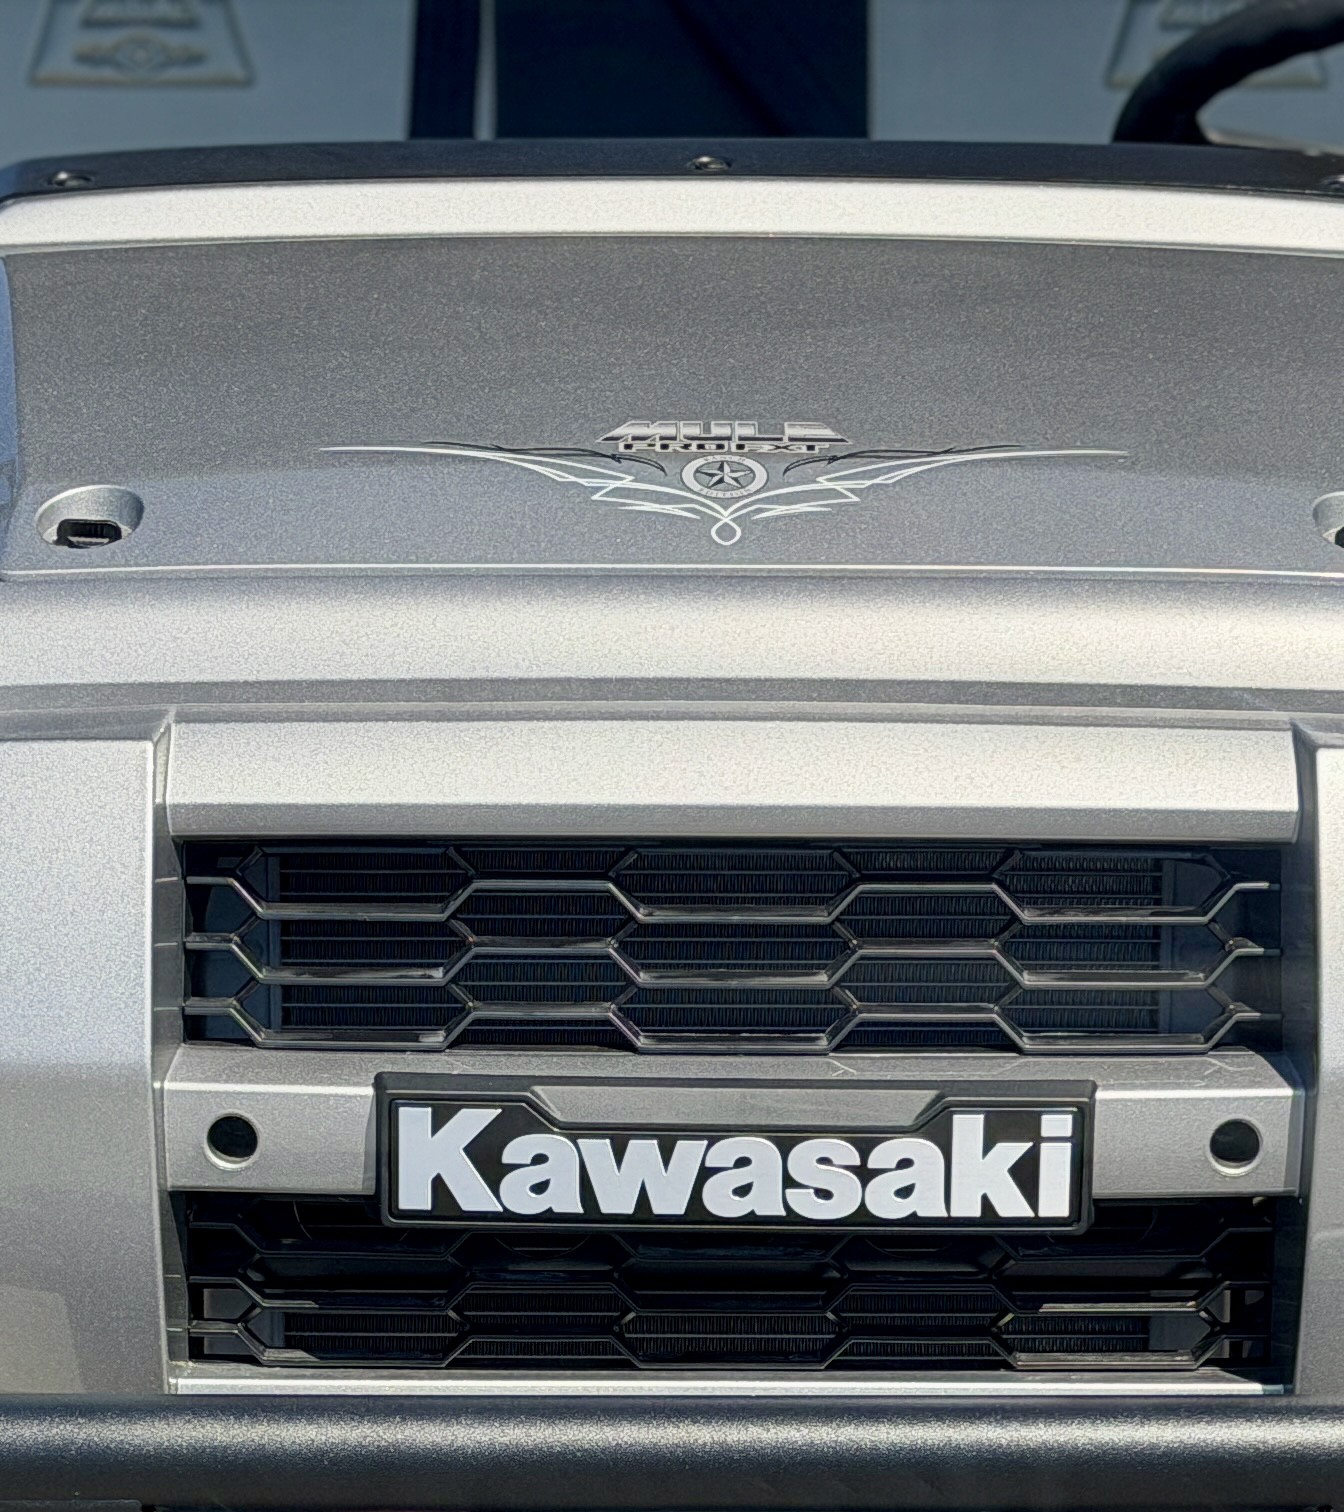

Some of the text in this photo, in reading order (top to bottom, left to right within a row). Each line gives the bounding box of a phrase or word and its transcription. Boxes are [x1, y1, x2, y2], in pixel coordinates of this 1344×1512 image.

[596, 420, 853, 443] MULE
[618, 441, 729, 453] PRO
[397, 1106, 1073, 1221] Kawasaki
